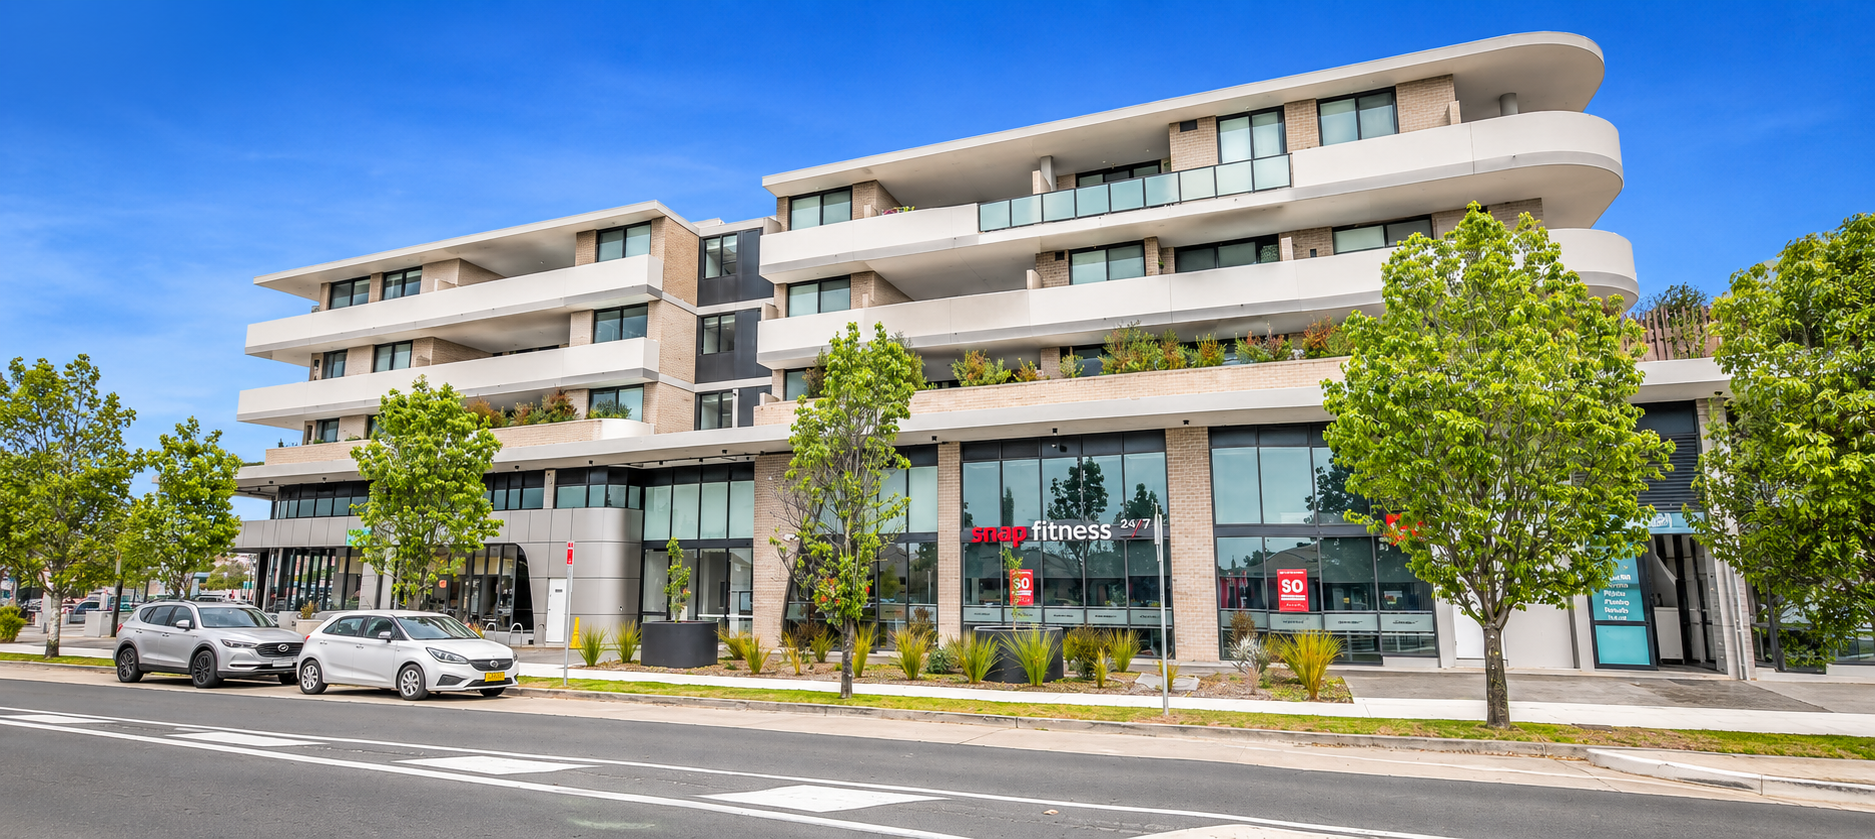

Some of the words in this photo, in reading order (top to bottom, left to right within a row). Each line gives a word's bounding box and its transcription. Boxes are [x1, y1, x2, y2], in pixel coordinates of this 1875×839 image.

[971, 526, 1028, 548] snap
[1031, 520, 1112, 541] fitness
[1120, 518, 1151, 538] 24/7
